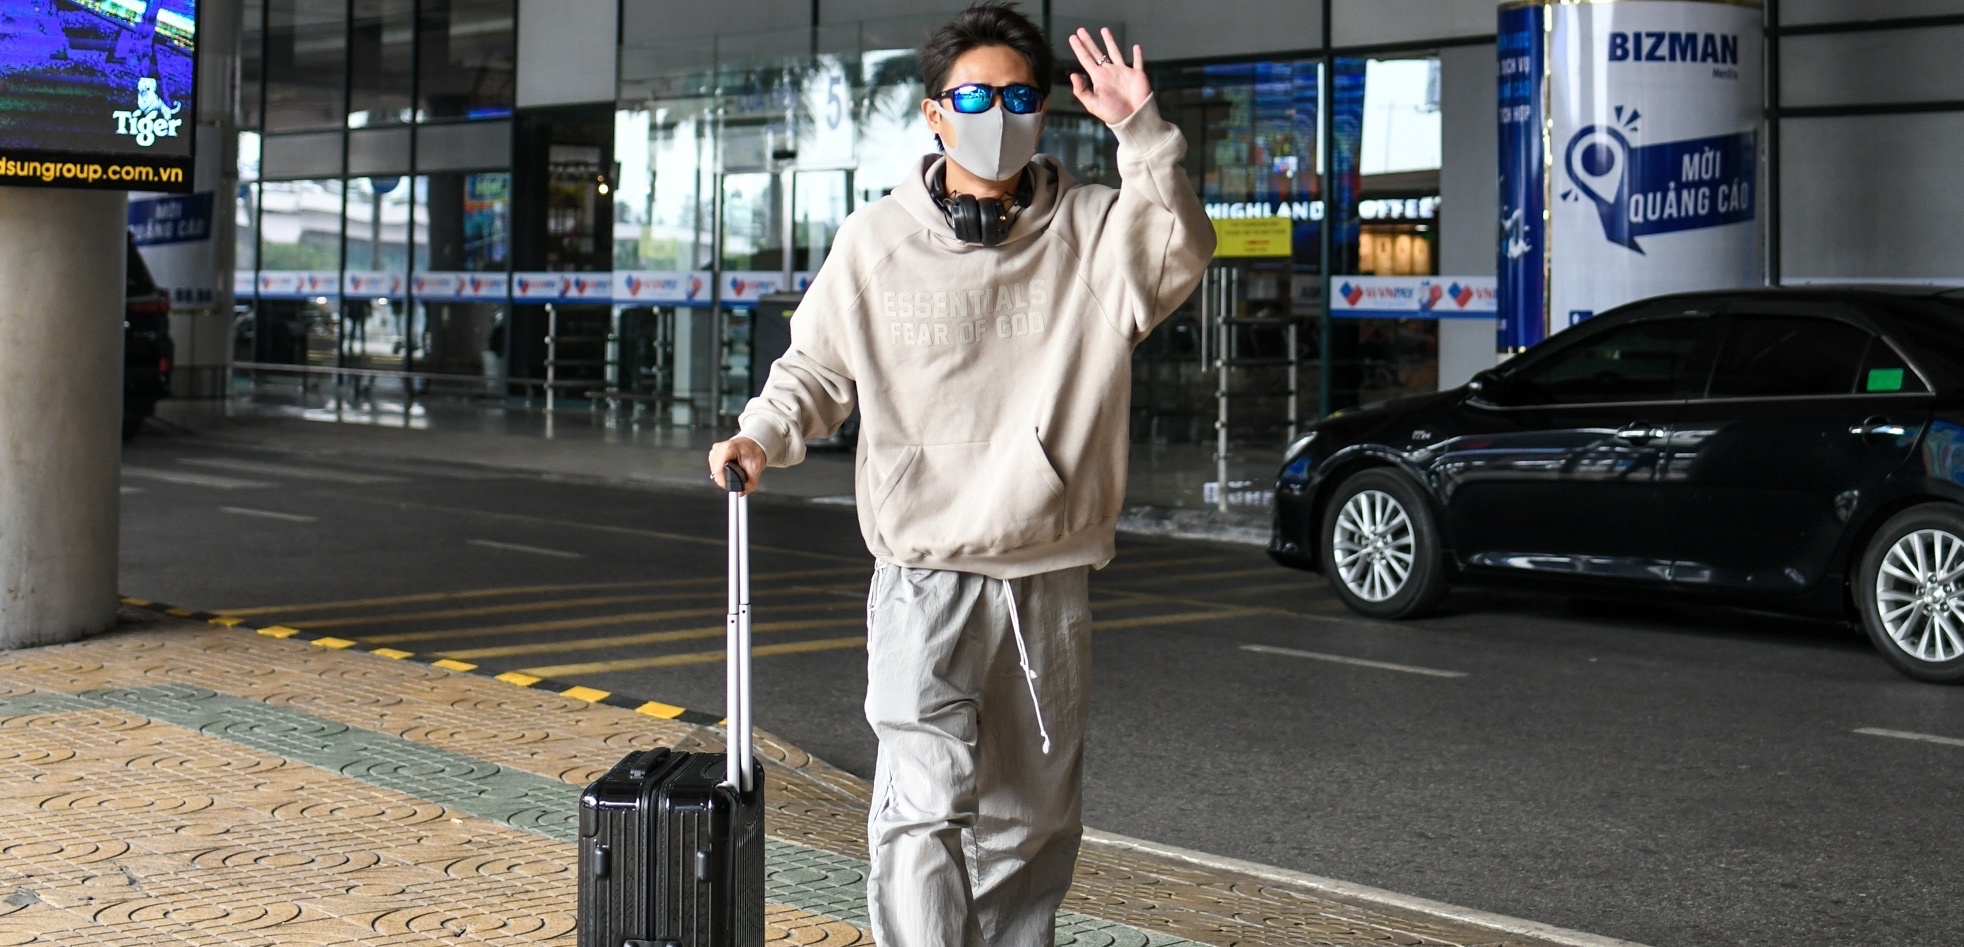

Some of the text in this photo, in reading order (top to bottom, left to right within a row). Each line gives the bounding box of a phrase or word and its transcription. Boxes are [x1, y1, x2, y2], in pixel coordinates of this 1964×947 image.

[1608, 31, 1738, 64] BIZMAN
[827, 76, 841, 130] 5
[112, 109, 182, 146] Tiger
[1681, 146, 1721, 182] MỜI
[1629, 177, 1749, 223] QUẢNG CÁO
[882, 279, 1048, 318] ESSENTIALS
[890, 311, 1045, 347] FEAR OF GOD
